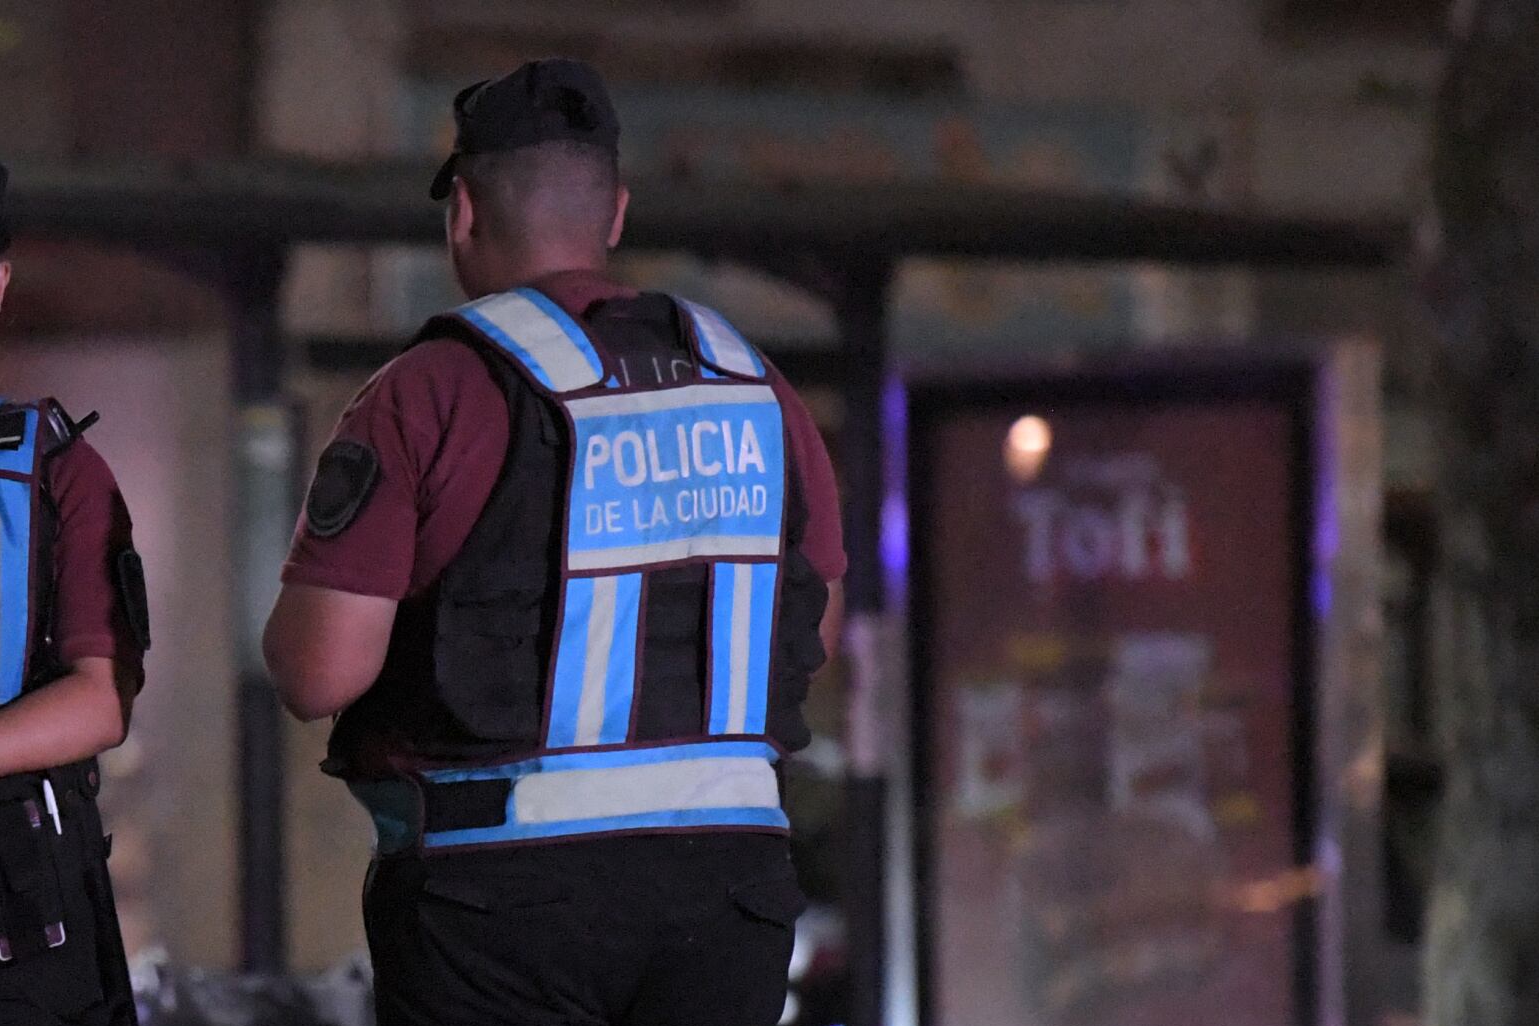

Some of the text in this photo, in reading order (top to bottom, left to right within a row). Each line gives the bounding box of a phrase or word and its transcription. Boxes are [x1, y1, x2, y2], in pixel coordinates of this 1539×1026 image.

[584, 419, 766, 490] POLICIA
[585, 484, 767, 535] DE LA CIUDAD
